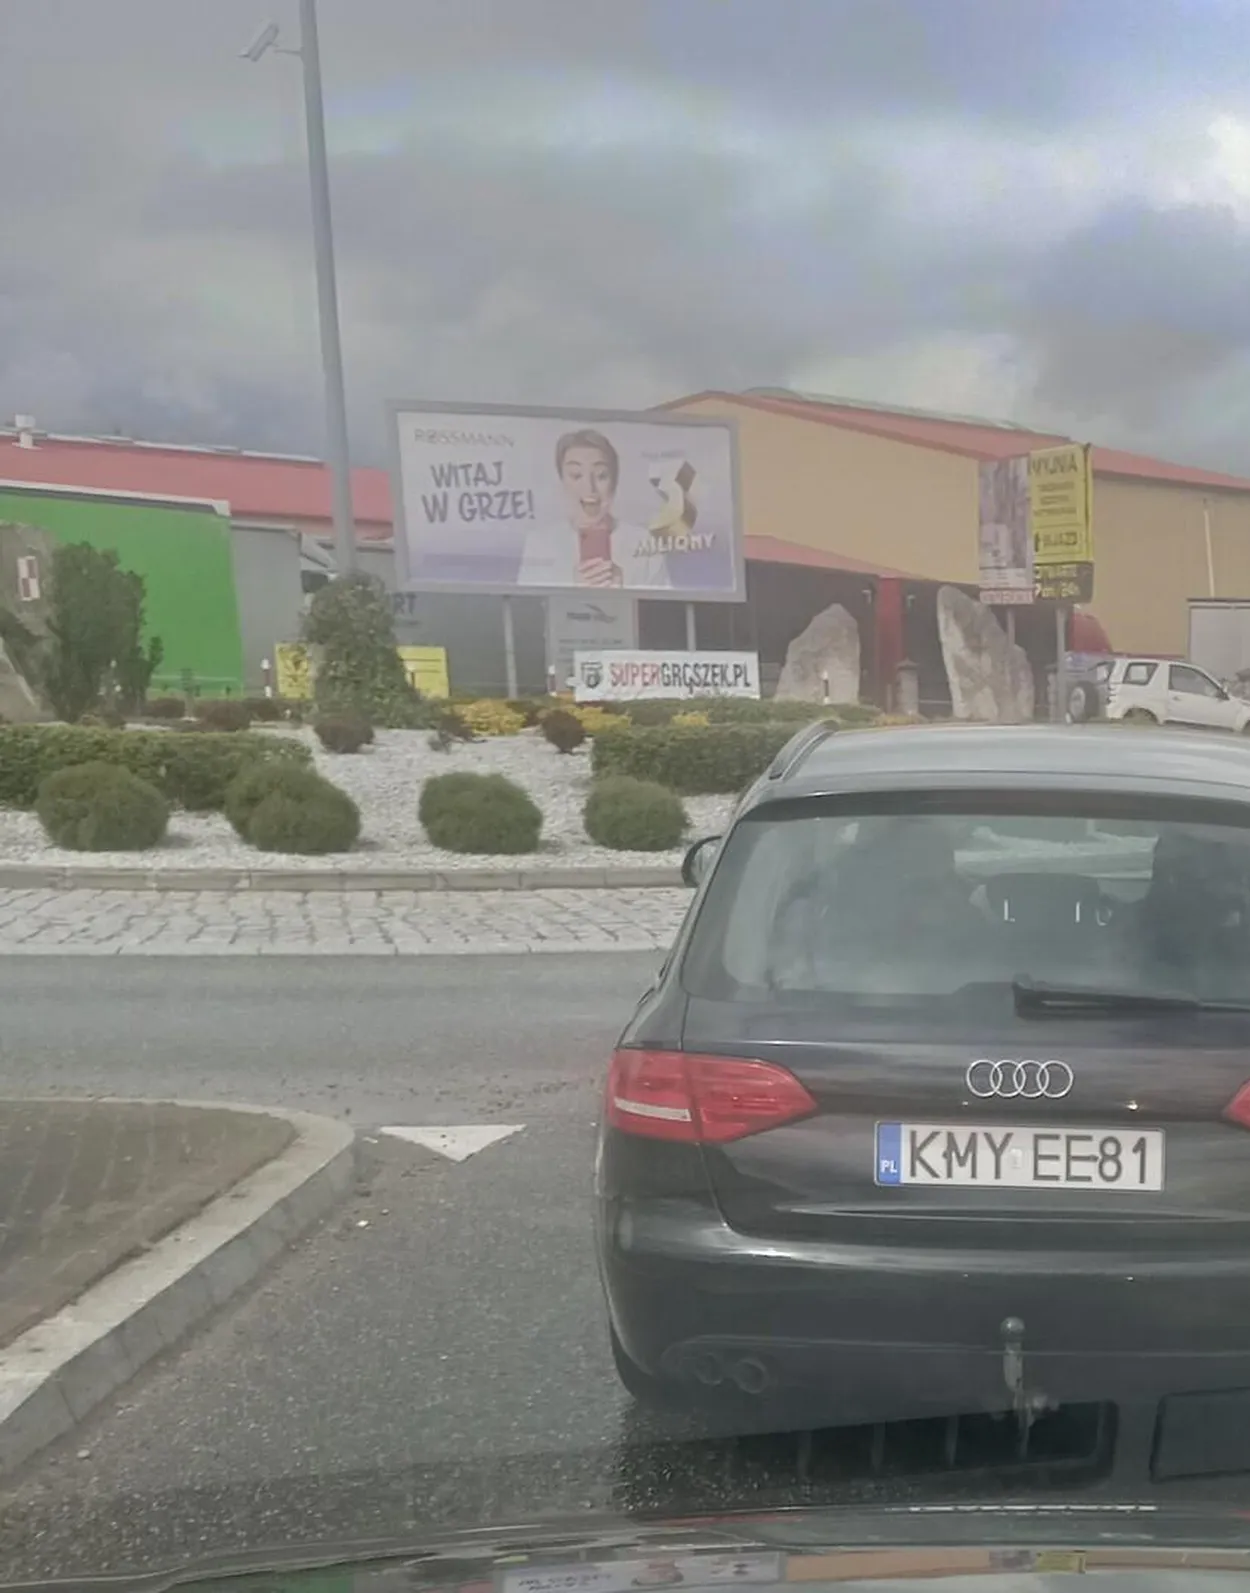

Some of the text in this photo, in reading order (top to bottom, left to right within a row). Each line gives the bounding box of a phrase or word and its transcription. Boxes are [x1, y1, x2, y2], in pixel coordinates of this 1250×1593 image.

[430, 461, 503, 488] WITAJ
[421, 489, 536, 523] W GRZE!
[880, 1160, 898, 1174] PL
[908, 1130, 1148, 1184] KMY EE81
